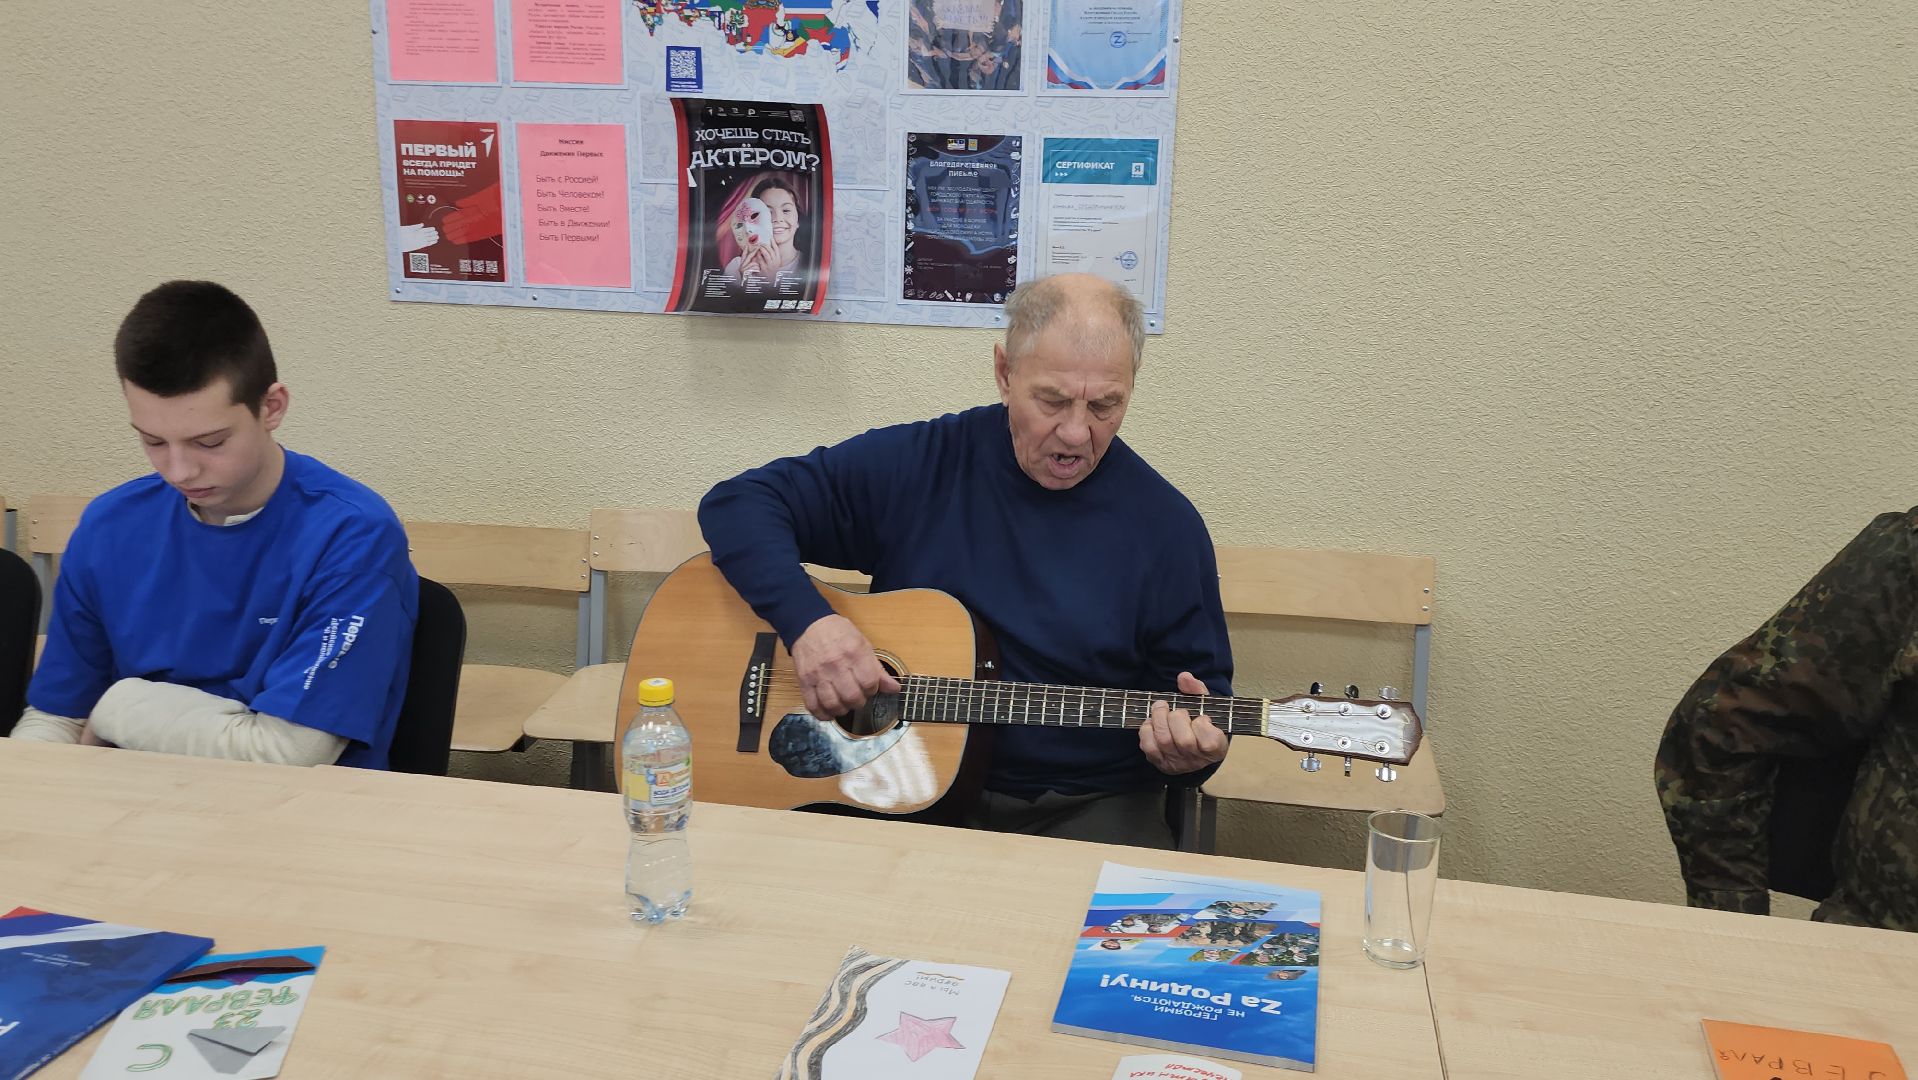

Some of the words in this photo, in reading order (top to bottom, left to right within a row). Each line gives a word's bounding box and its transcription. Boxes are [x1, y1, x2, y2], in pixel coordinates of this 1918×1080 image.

[695, 127, 759, 142] ХОЧЕШЬ
[762, 128, 812, 145] СТАТЬ
[400, 142, 477, 158] ПЕРВЫЙ
[690, 143, 820, 172] АКТЁРОМ?
[402, 159, 438, 168] ВСЕГДА
[1055, 161, 1115, 170] СЕРТИФИКАТ
[417, 169, 465, 177] ПОМОЩЬ!
[536, 175, 556, 183] Быть
[536, 189, 557, 198] Быть
[537, 204, 557, 212] Быть
[538, 218, 558, 227] Быть
[539, 233, 559, 242] Быть
[1099, 973, 1232, 1006] Родину!
[131, 985, 300, 1021] ФЕВРАЛЯ
[1154, 1004, 1218, 1021] ГЕРОЯМИ
[1227, 1008, 1246, 1018] НЕ
[211, 1008, 263, 1030] 23
